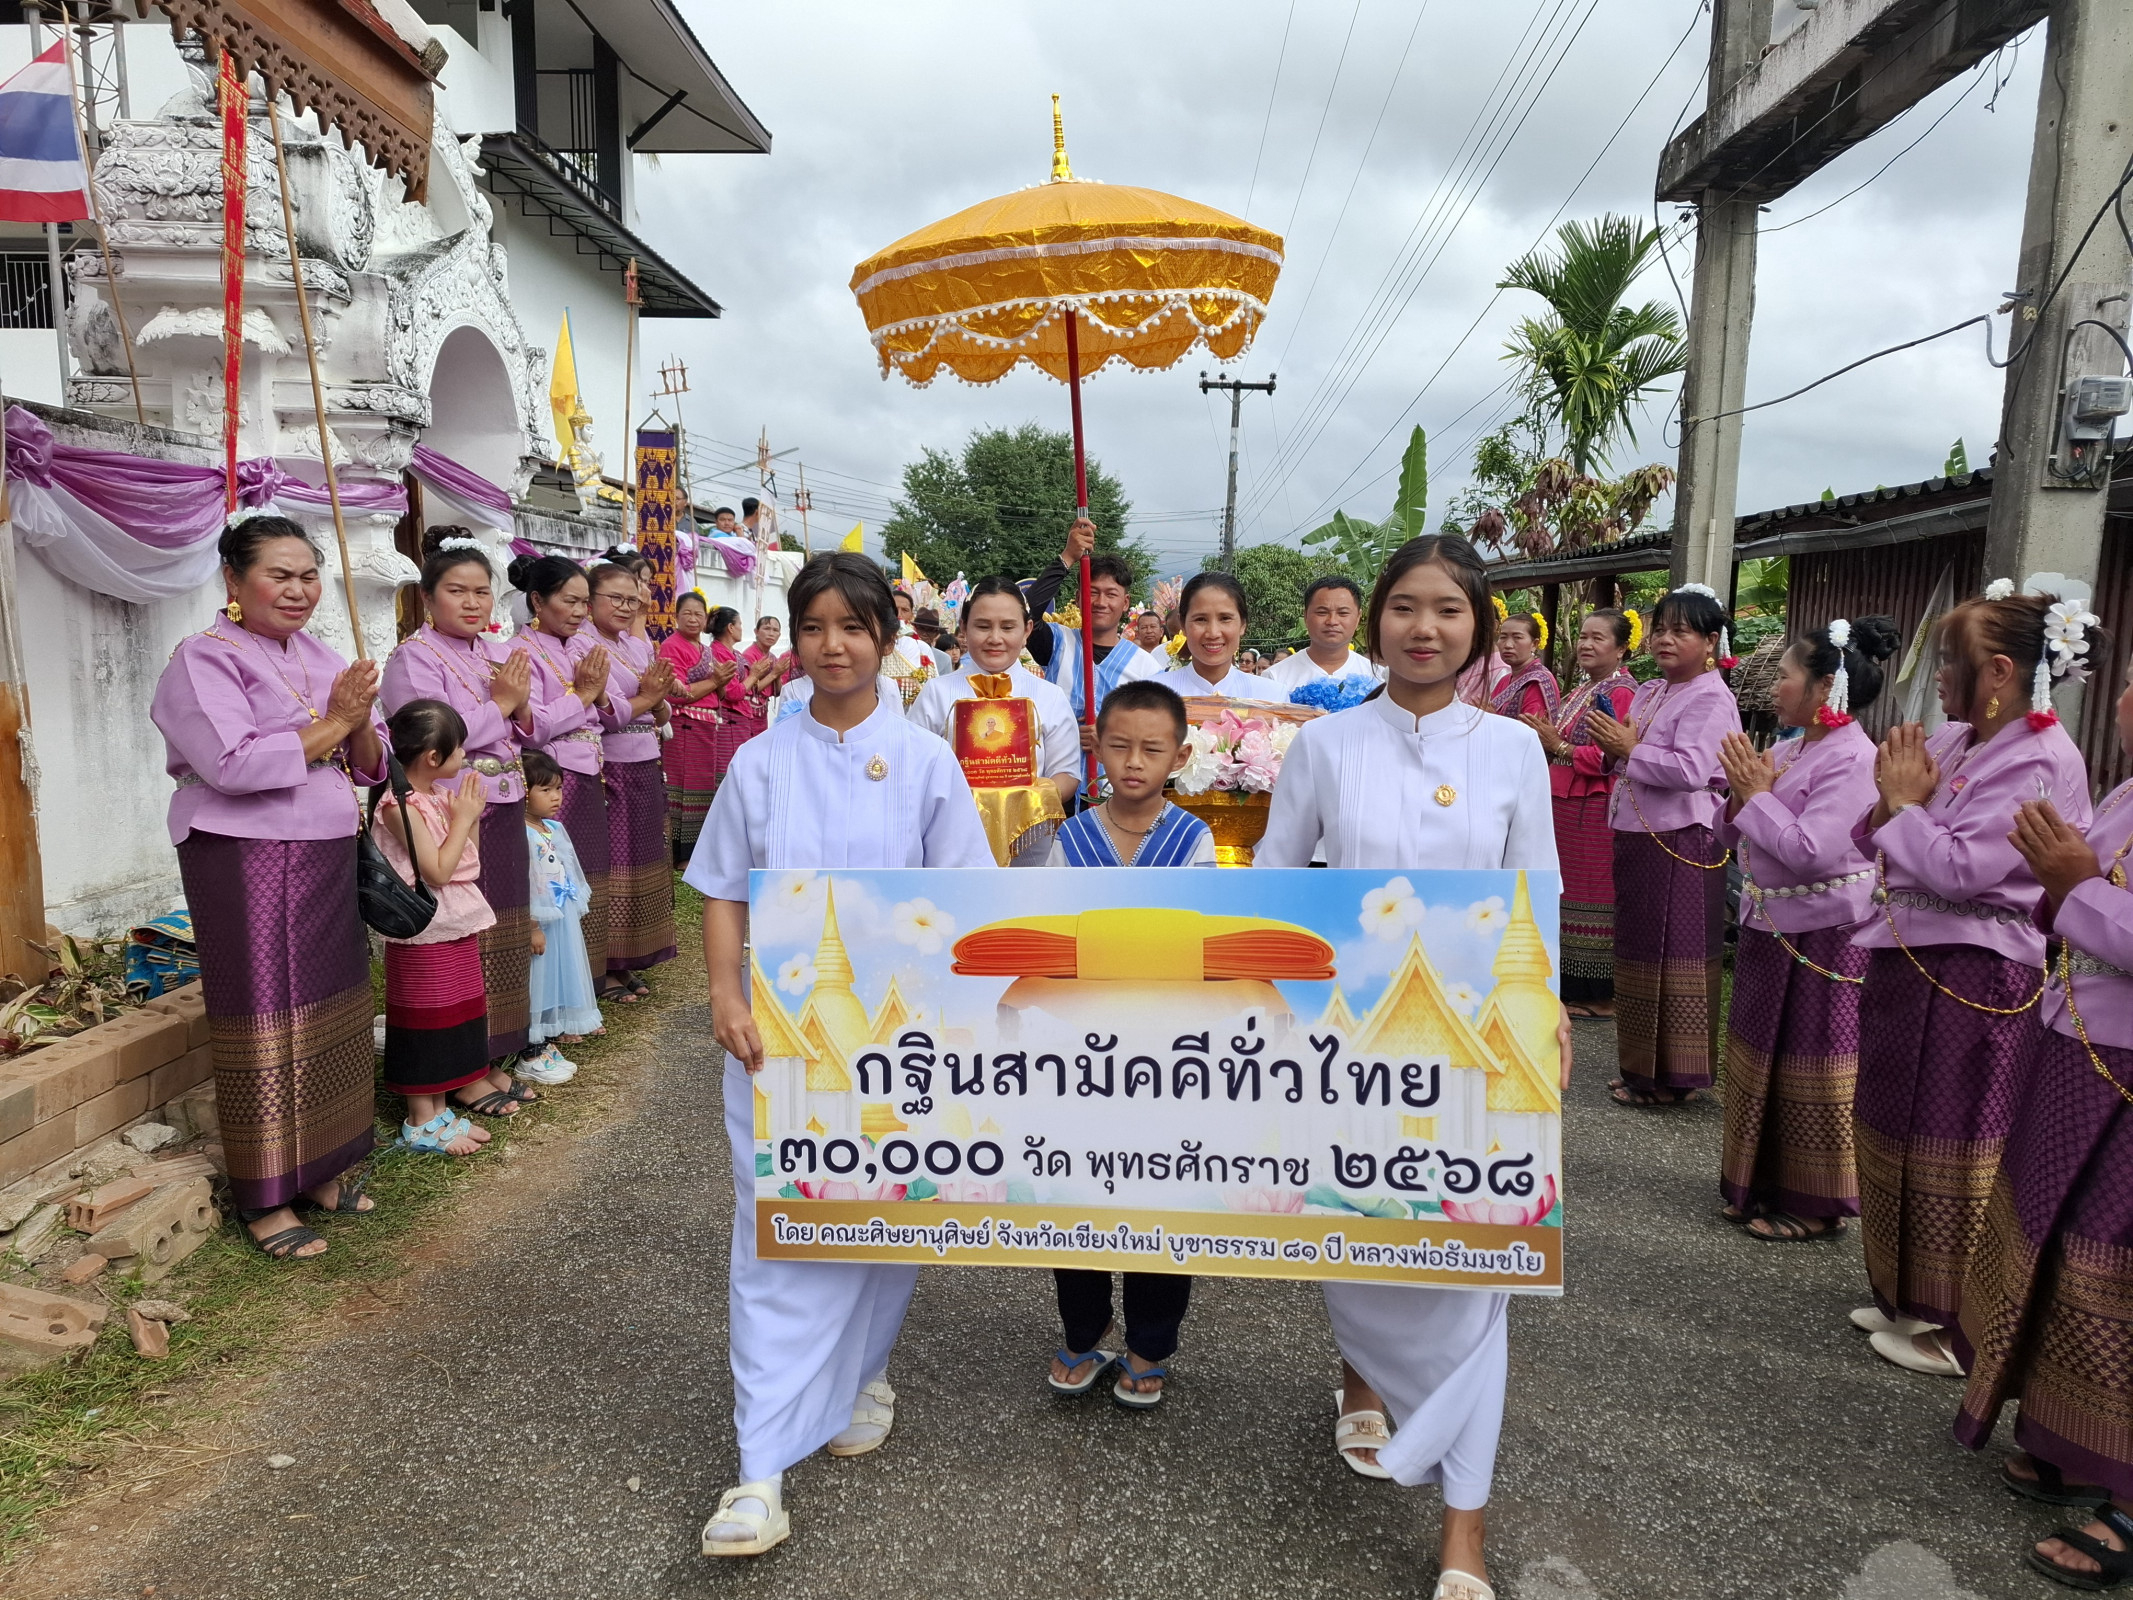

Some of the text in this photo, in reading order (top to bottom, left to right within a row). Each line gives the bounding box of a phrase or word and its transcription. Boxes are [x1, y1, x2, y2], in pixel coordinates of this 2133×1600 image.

[856, 1016, 1441, 1115] กฐินสามัคคีทั่วไทย
[780, 1135, 1535, 1197] ๓๐,๐๐๐ วัด พุทธศักราช ๒๕๖๘
[774, 1217, 1541, 1272] โดย คณะศิษยานุศิษย์ จังหวัดเชียงใหม่ บูชาธรรม ๘๑ ปี หลวงพ่อธัมมชโย
